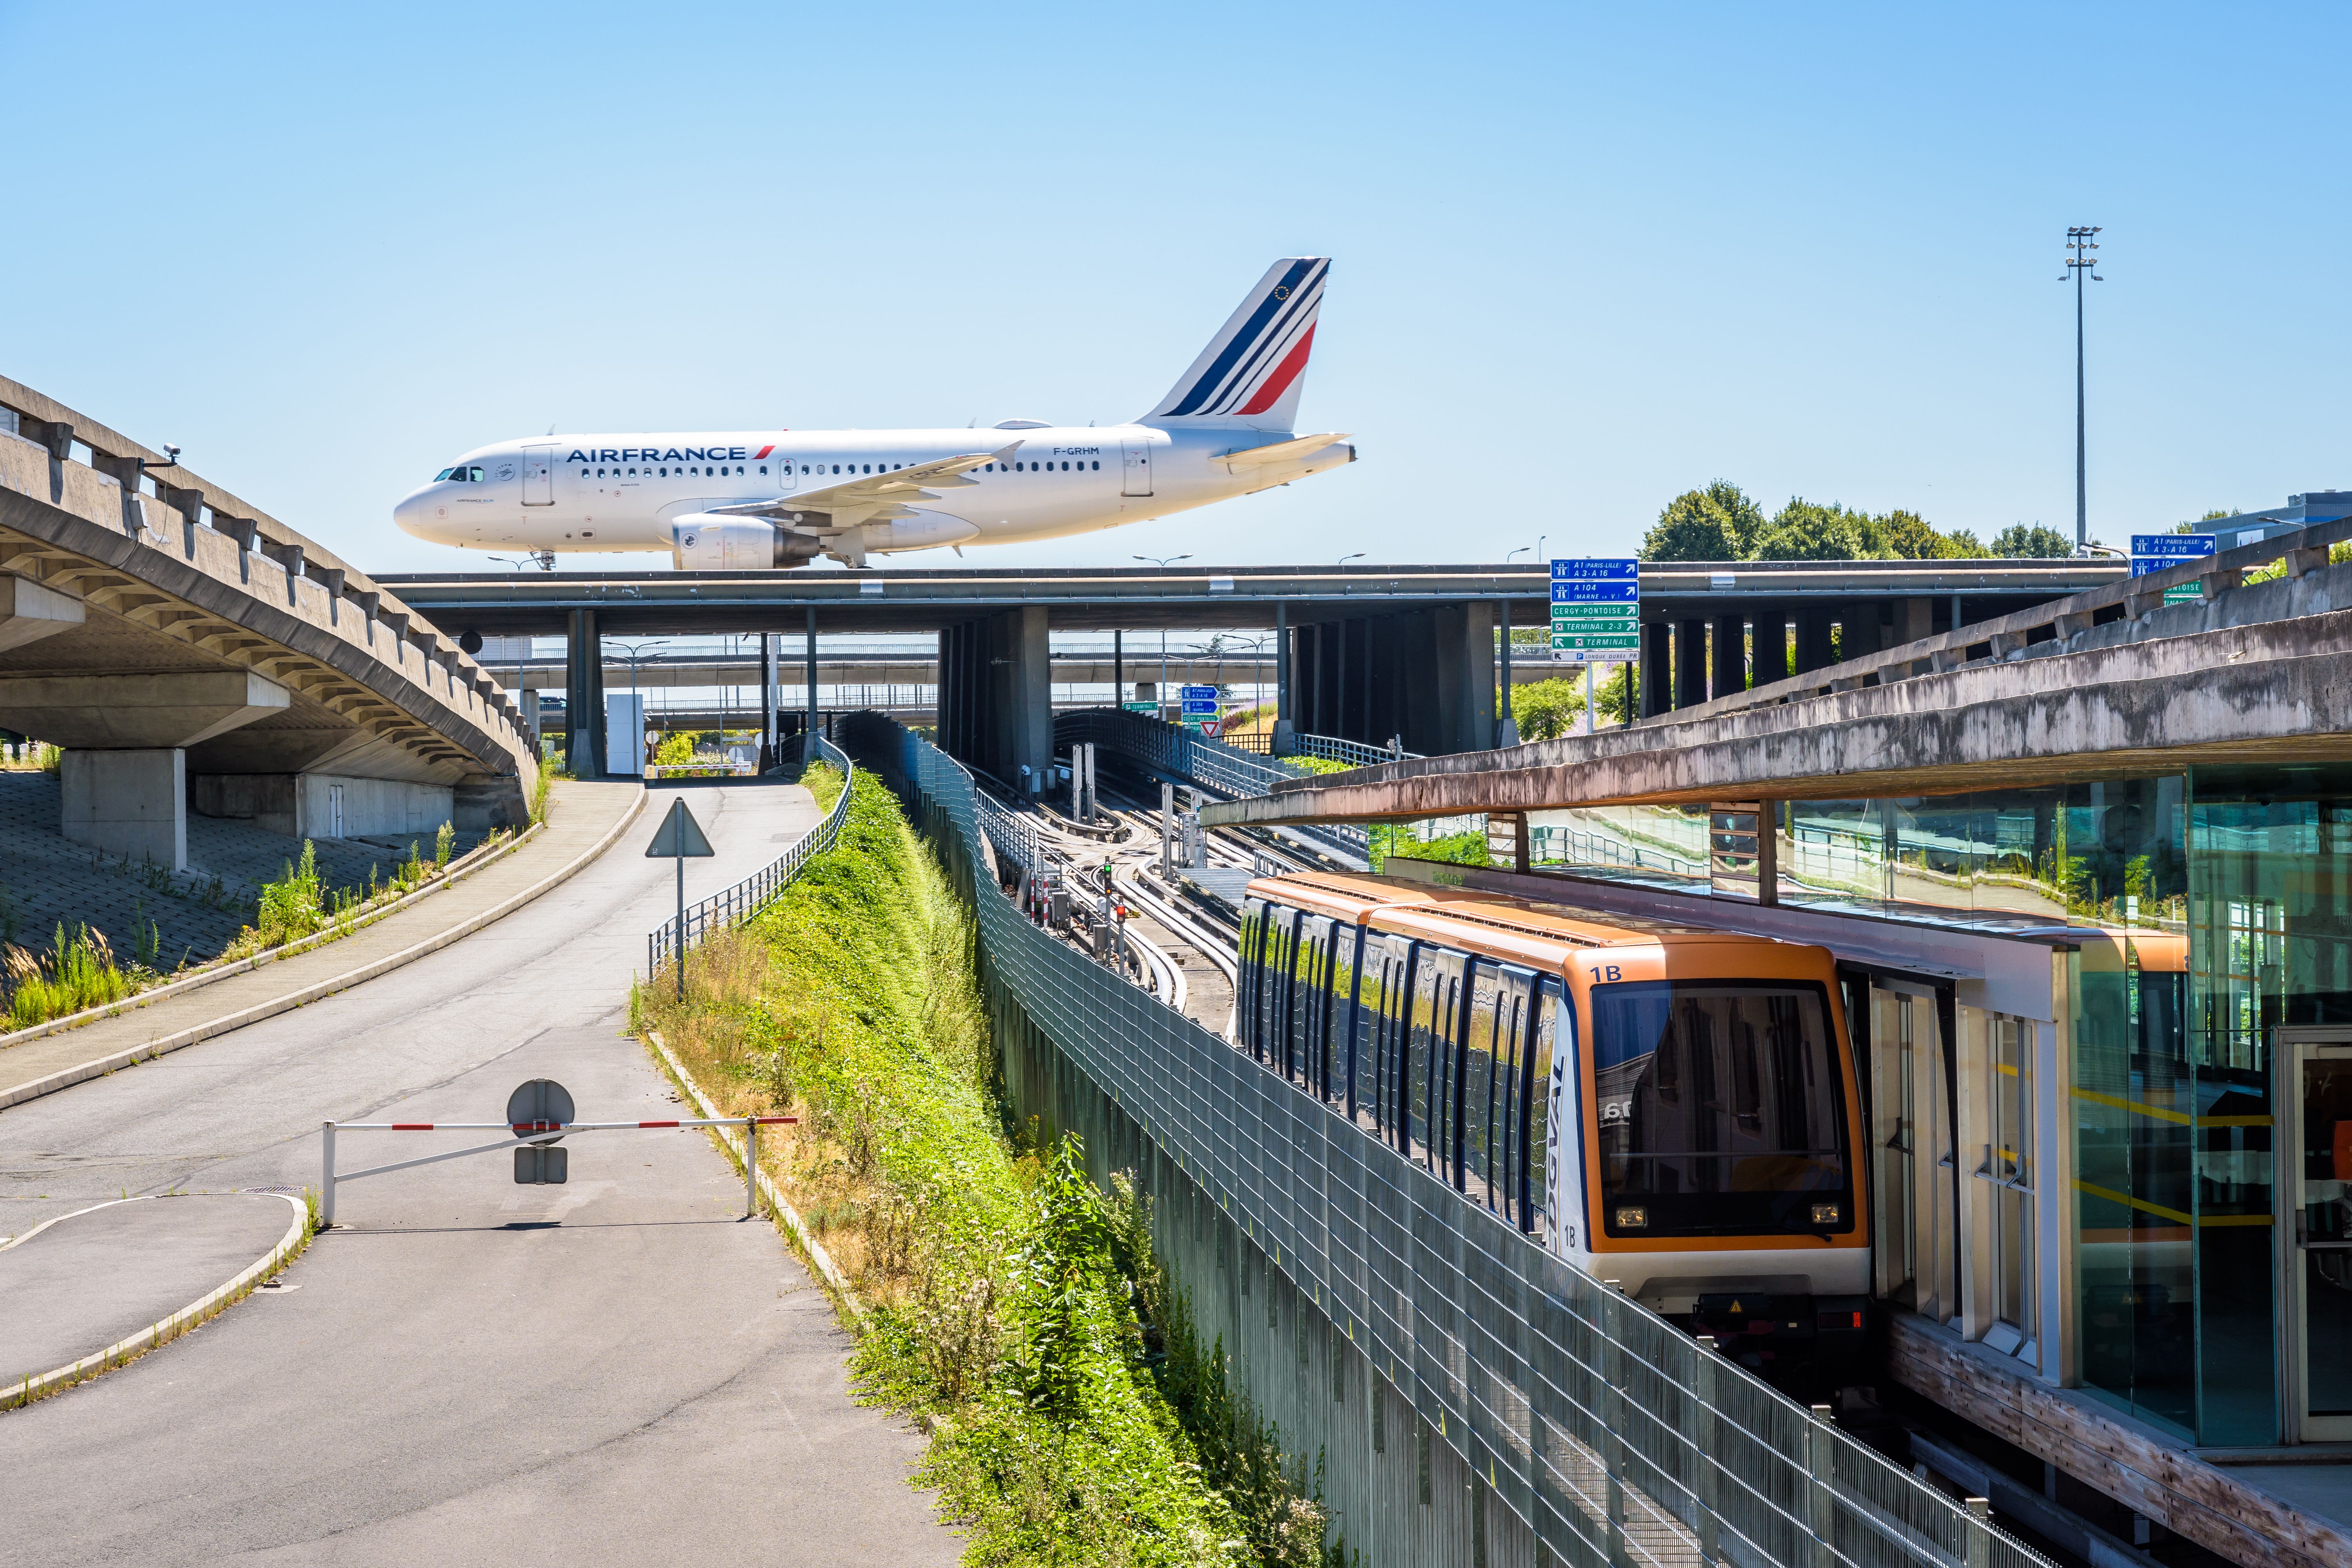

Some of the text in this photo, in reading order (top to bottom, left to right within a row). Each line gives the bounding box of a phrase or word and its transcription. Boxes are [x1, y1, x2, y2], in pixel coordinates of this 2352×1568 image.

[566, 447, 746, 463] AIRFRANCE
[1054, 447, 1100, 455] F-GRHM
[1590, 965, 1622, 983] 1B
[1564, 1225, 1575, 1248] 1B
